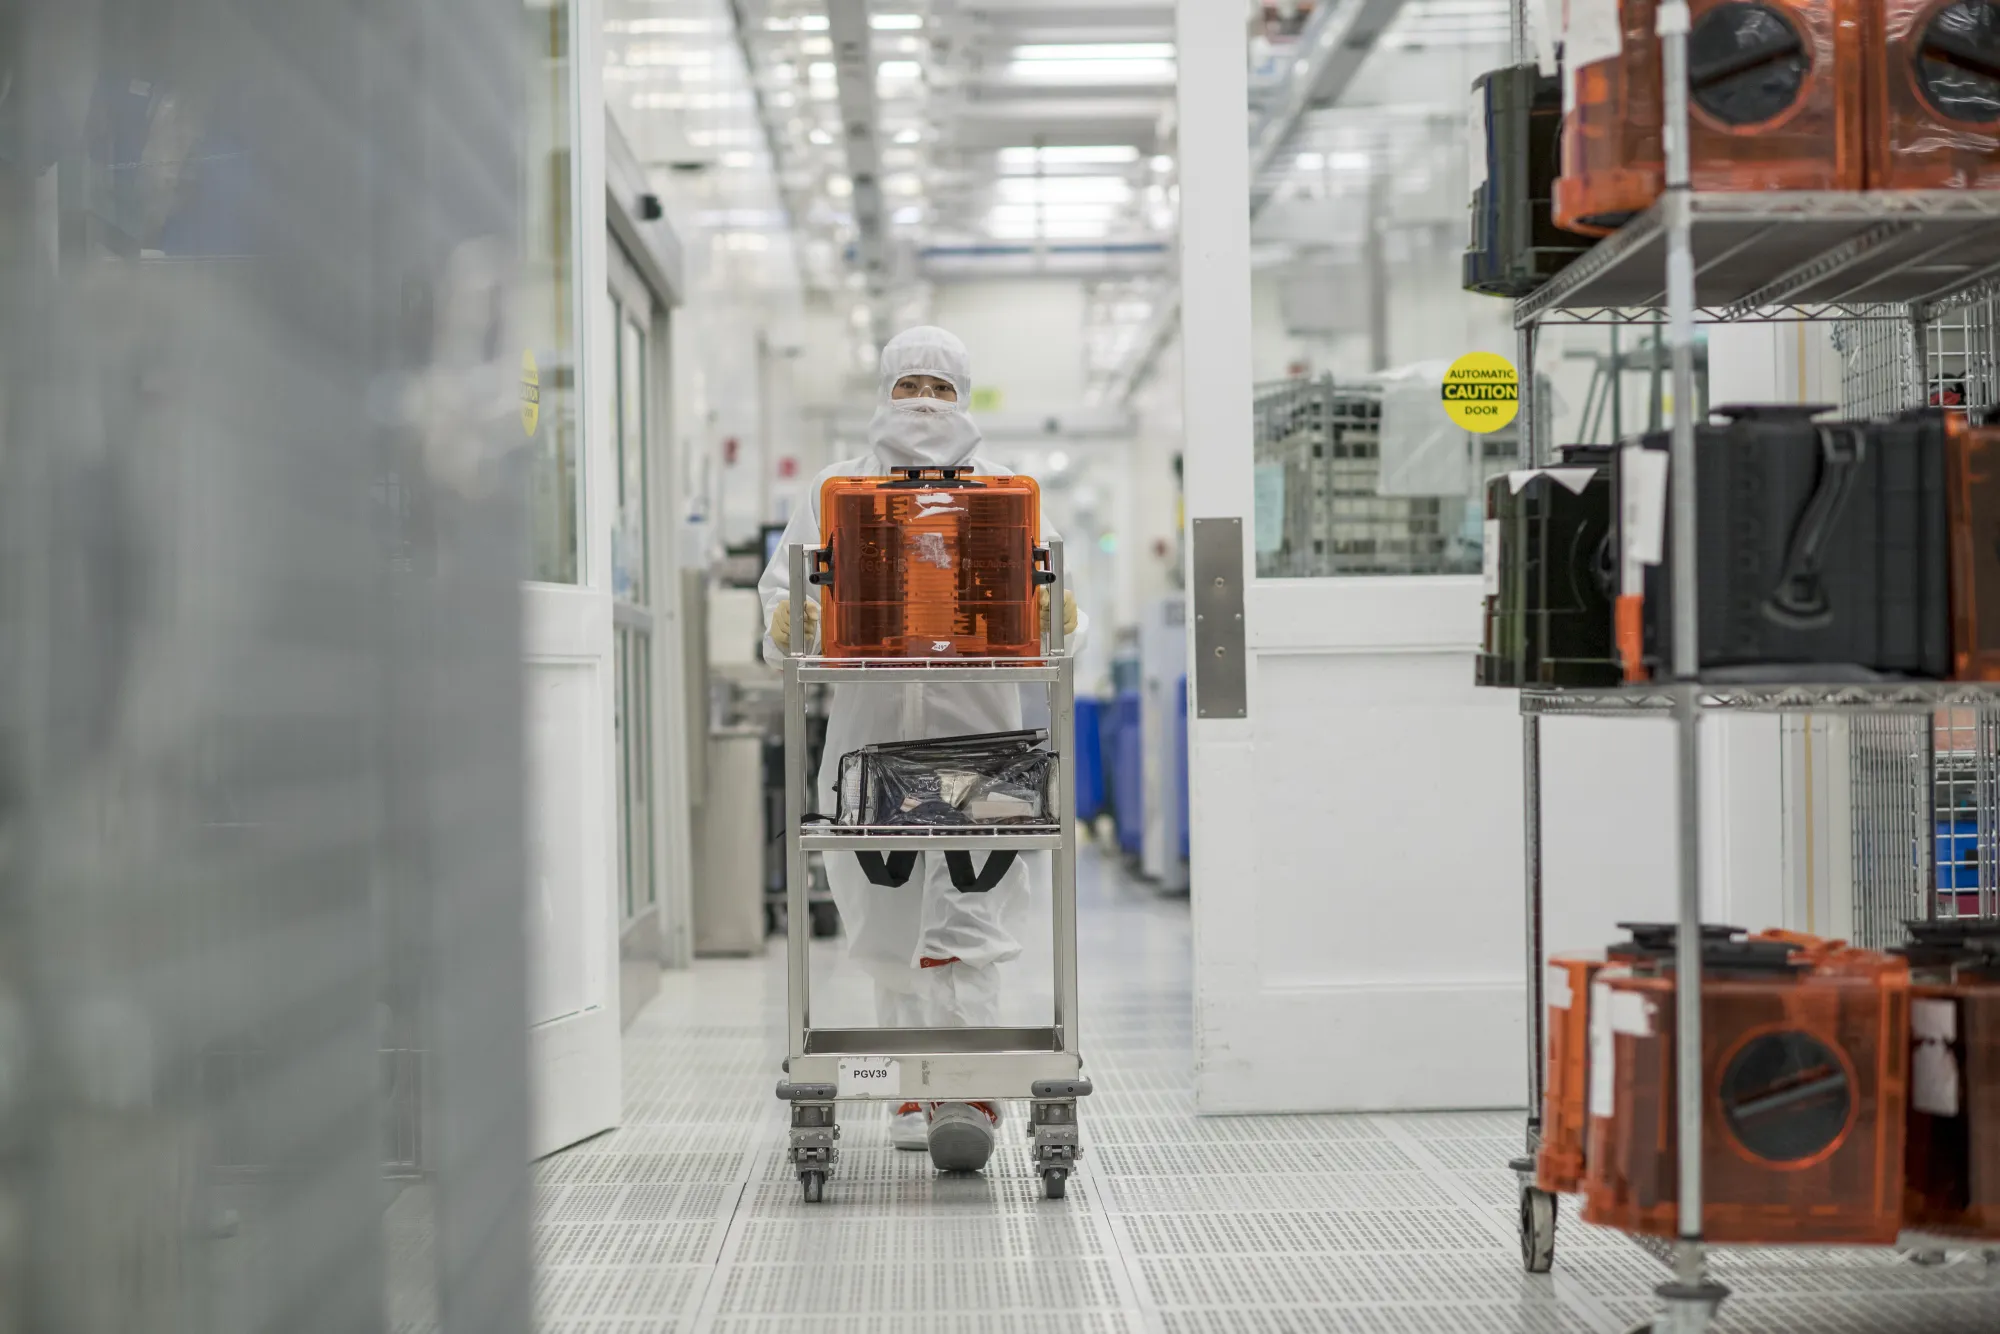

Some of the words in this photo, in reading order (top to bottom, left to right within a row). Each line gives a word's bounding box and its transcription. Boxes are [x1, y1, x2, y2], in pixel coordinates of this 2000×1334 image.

[1449, 369, 1514, 379] AUTOMATIC
[1444, 384, 1518, 399] CAUTION
[1464, 405, 1498, 415] DOOR
[853, 1069, 887, 1079] PGV39
